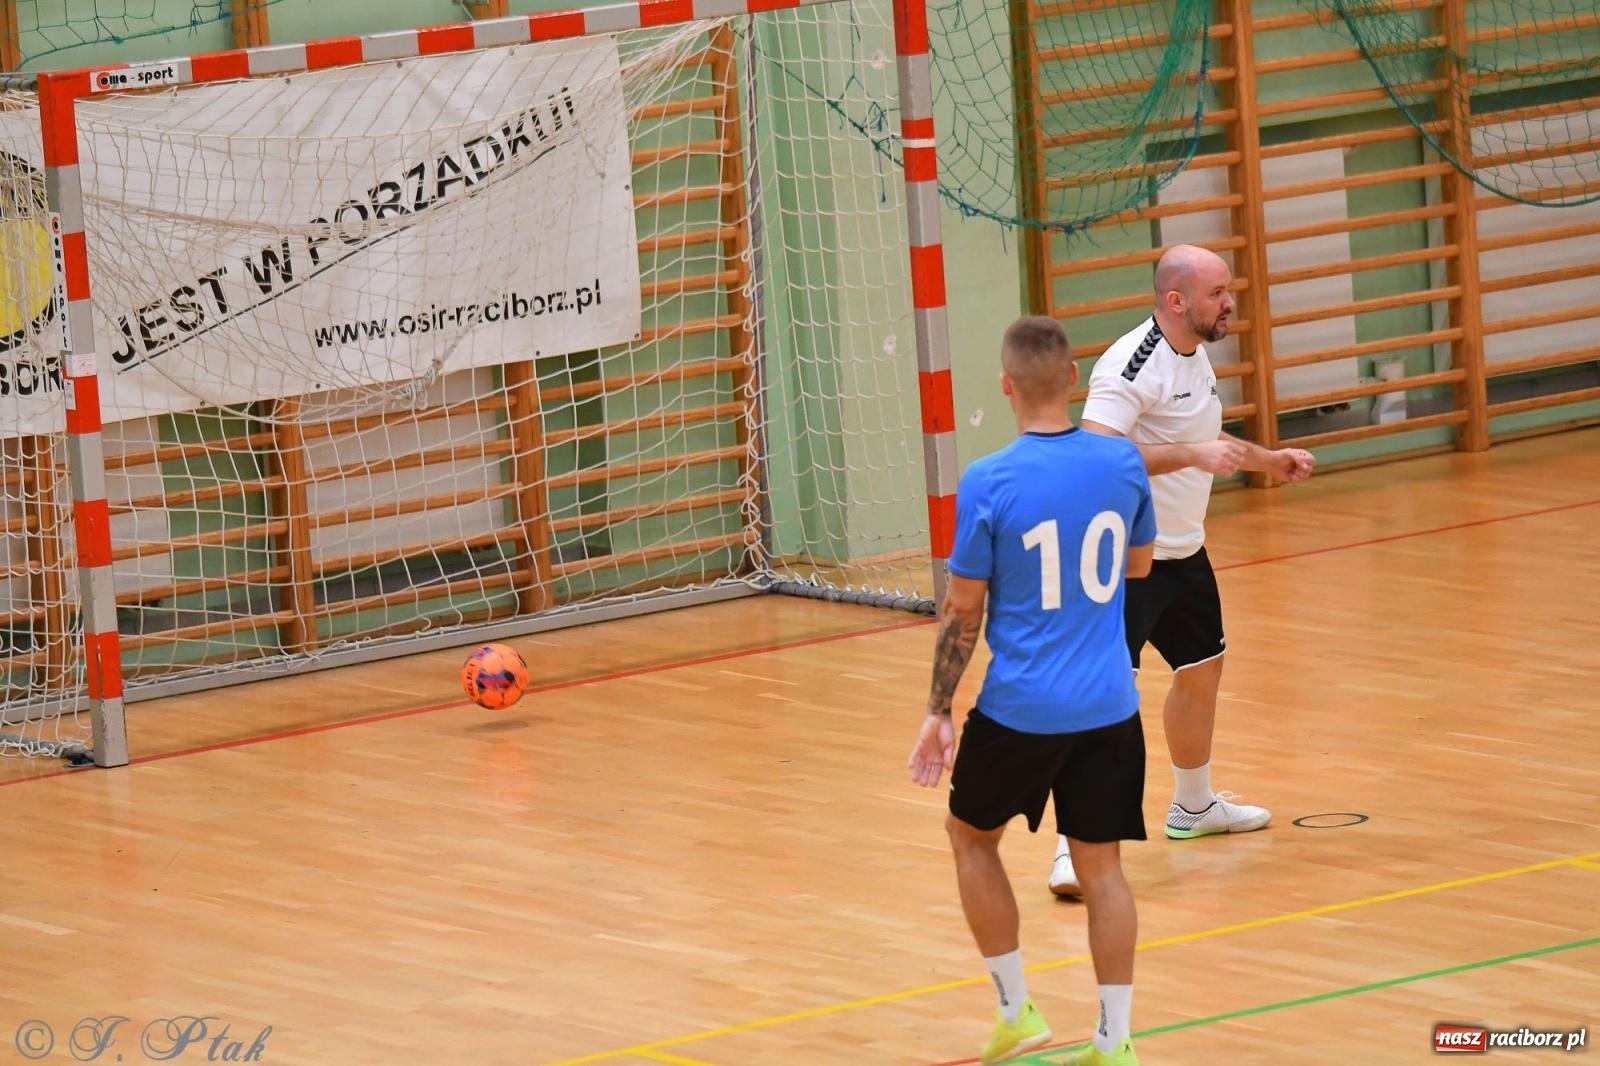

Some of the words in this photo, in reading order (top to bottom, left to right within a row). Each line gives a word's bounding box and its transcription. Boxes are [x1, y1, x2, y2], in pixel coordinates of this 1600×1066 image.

[138, 66, 174, 84] sport
[58, 283, 69, 349] sport
[112, 266, 228, 364] JEST
[242, 236, 294, 295] W
[315, 279, 602, 348] www.osir-raciborz.pl
[1022, 510, 1126, 610] 10
